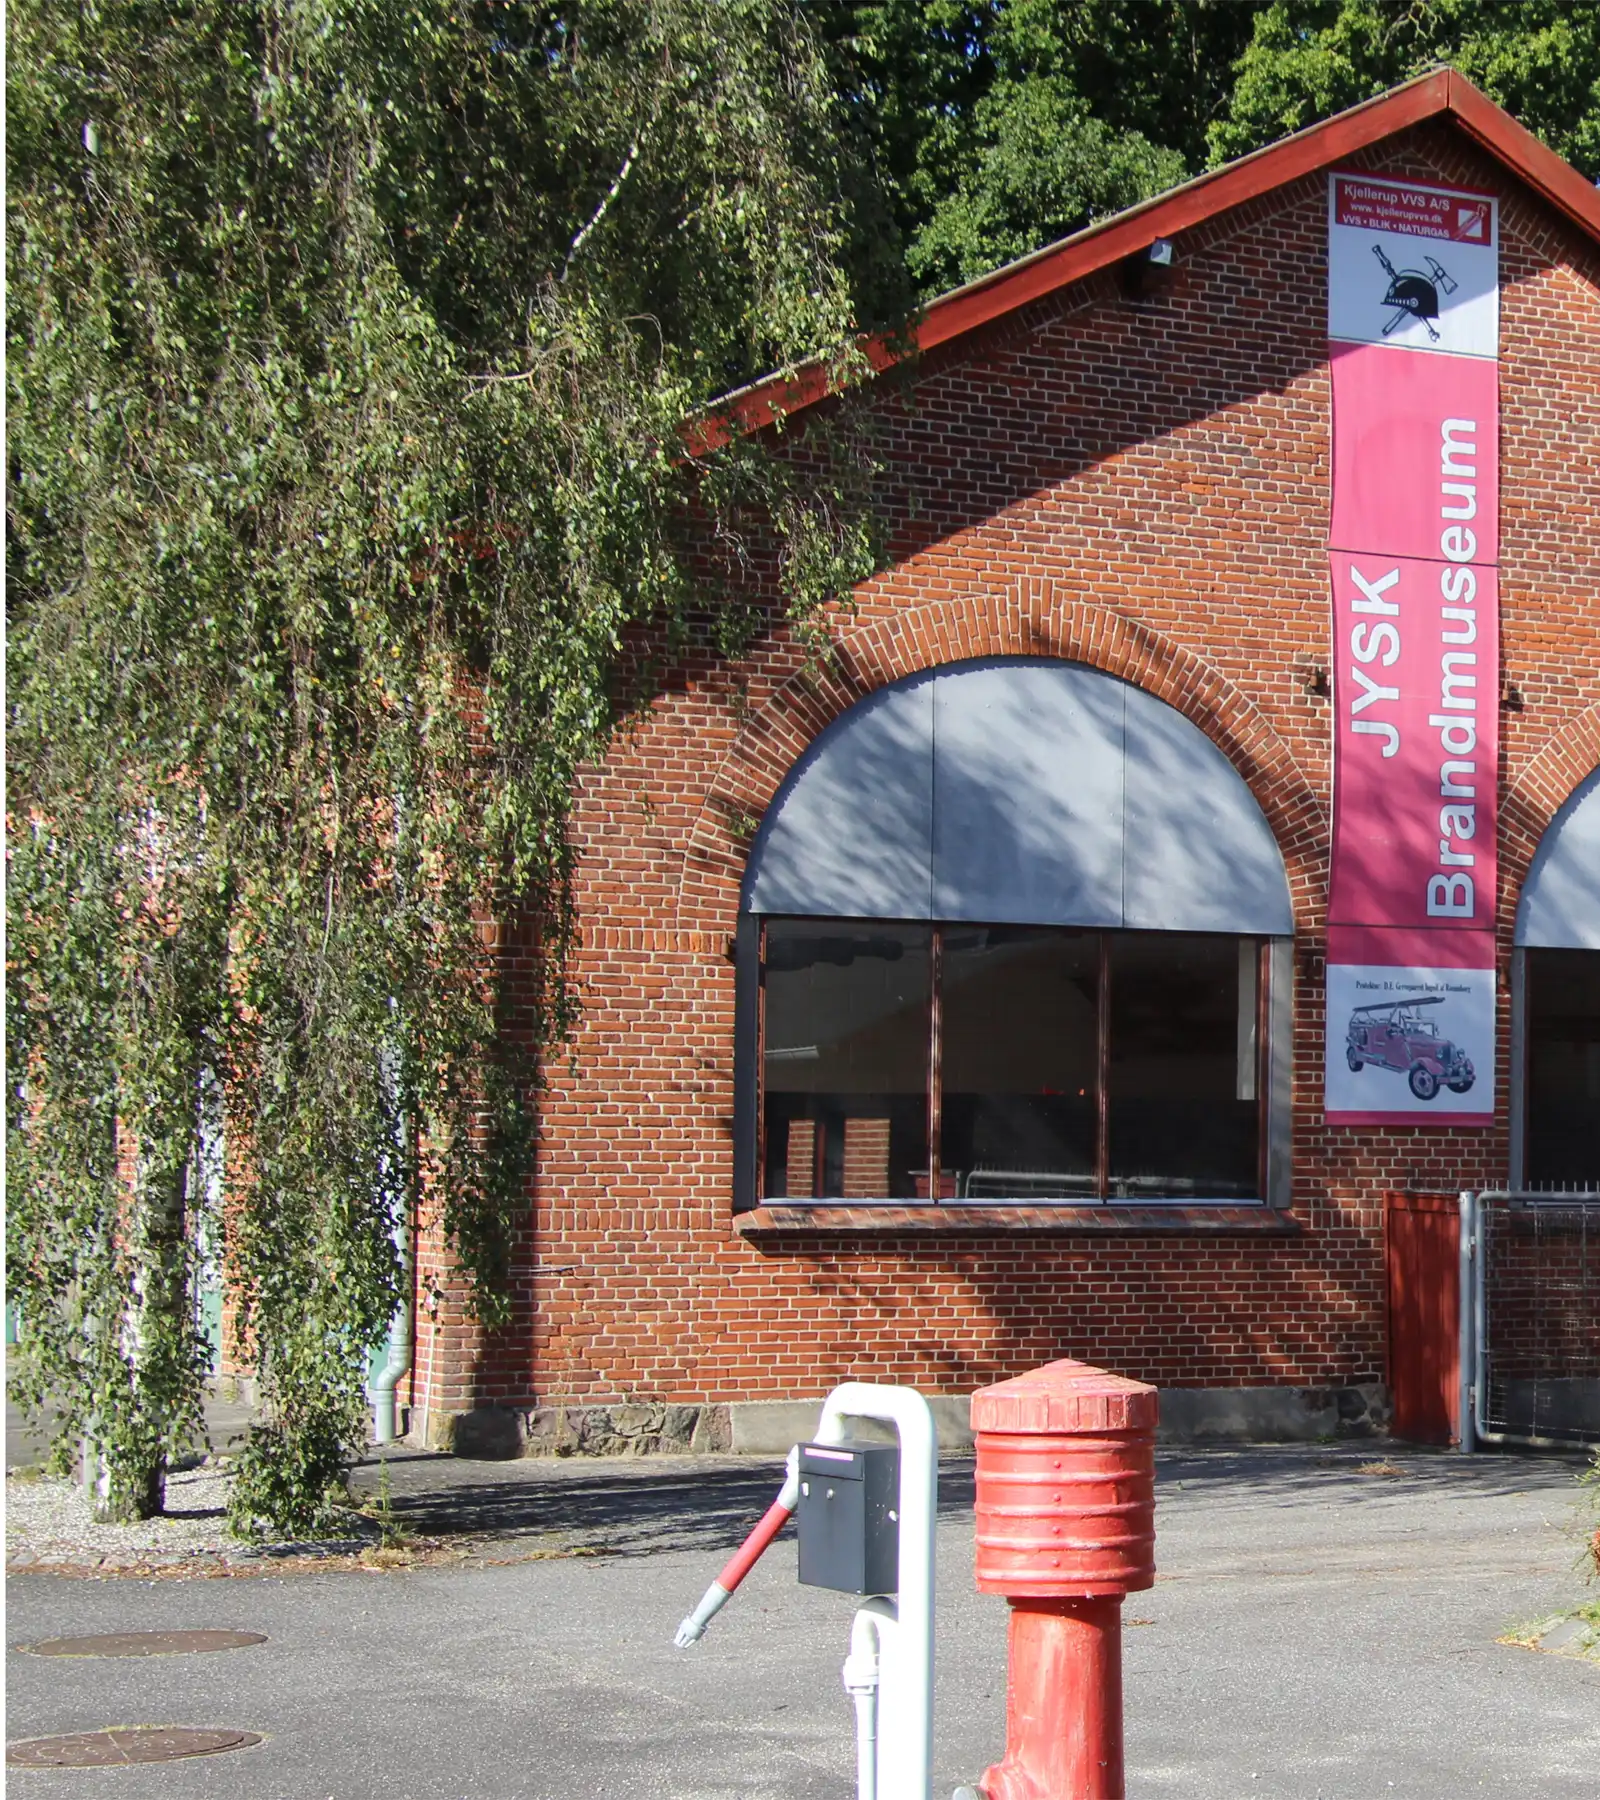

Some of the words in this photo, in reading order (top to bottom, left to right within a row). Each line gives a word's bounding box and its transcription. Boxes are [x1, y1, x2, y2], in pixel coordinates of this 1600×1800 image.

[1342, 214, 1361, 224] VVS
[1369, 218, 1391, 230] BLIK
[1398, 223, 1450, 238] NATURGAS
[1344, 185, 1397, 205] Kjellerup
[1401, 193, 1425, 208] VVS
[1429, 199, 1450, 211] A/S
[1351, 564, 1400, 758] JYSK
[1426, 417, 1477, 918] Brandmuseum
